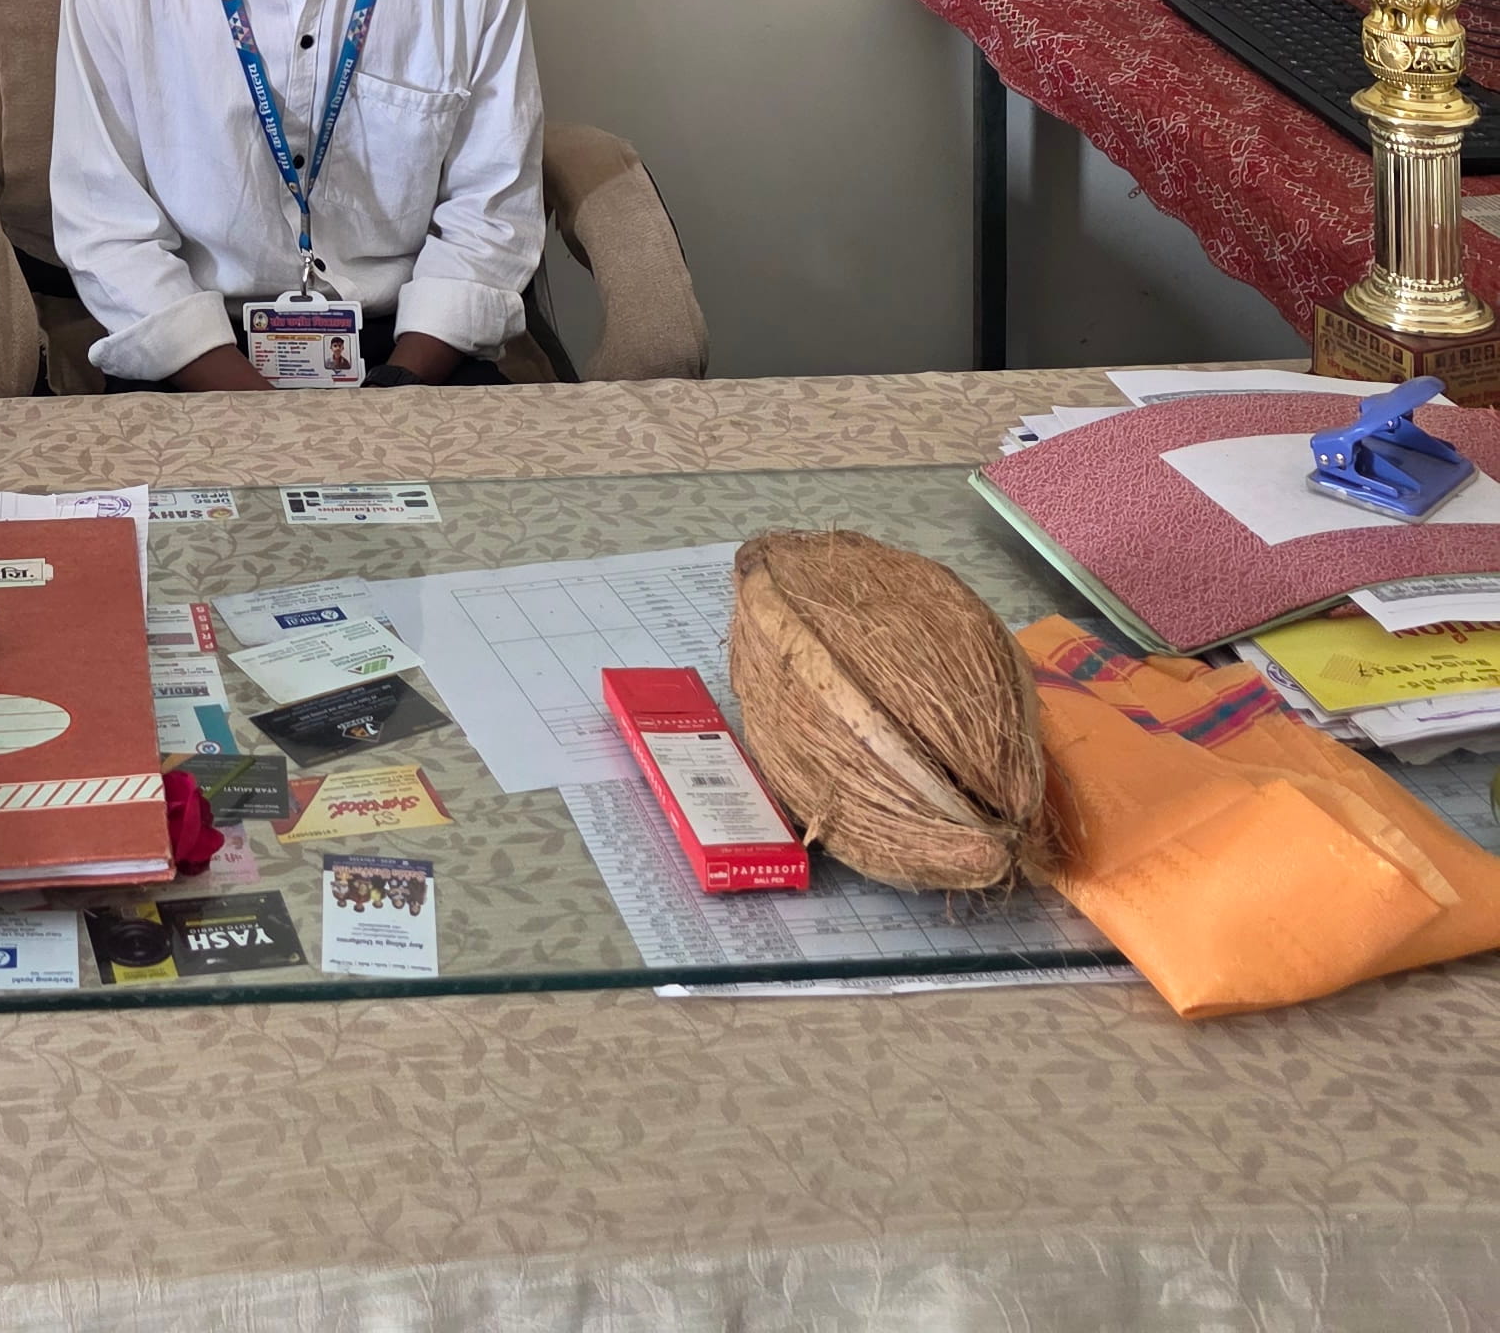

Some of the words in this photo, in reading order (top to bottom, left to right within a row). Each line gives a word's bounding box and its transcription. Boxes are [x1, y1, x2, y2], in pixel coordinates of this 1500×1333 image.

[248, 63, 271, 116] विद्यालय
[278, 151, 290, 170] संत
[195, 605, 214, 650] PRESS
[159, 685, 208, 696] MEDIA
[732, 864, 805, 876] PAPERSOFT
[189, 926, 224, 934] STUDIO
[227, 923, 259, 931] PHOTO
[188, 927, 274, 951] YASH
[336, 937, 372, 946] Uniforms
[386, 940, 406, 949] thing
[409, 941, 423, 950] Any
